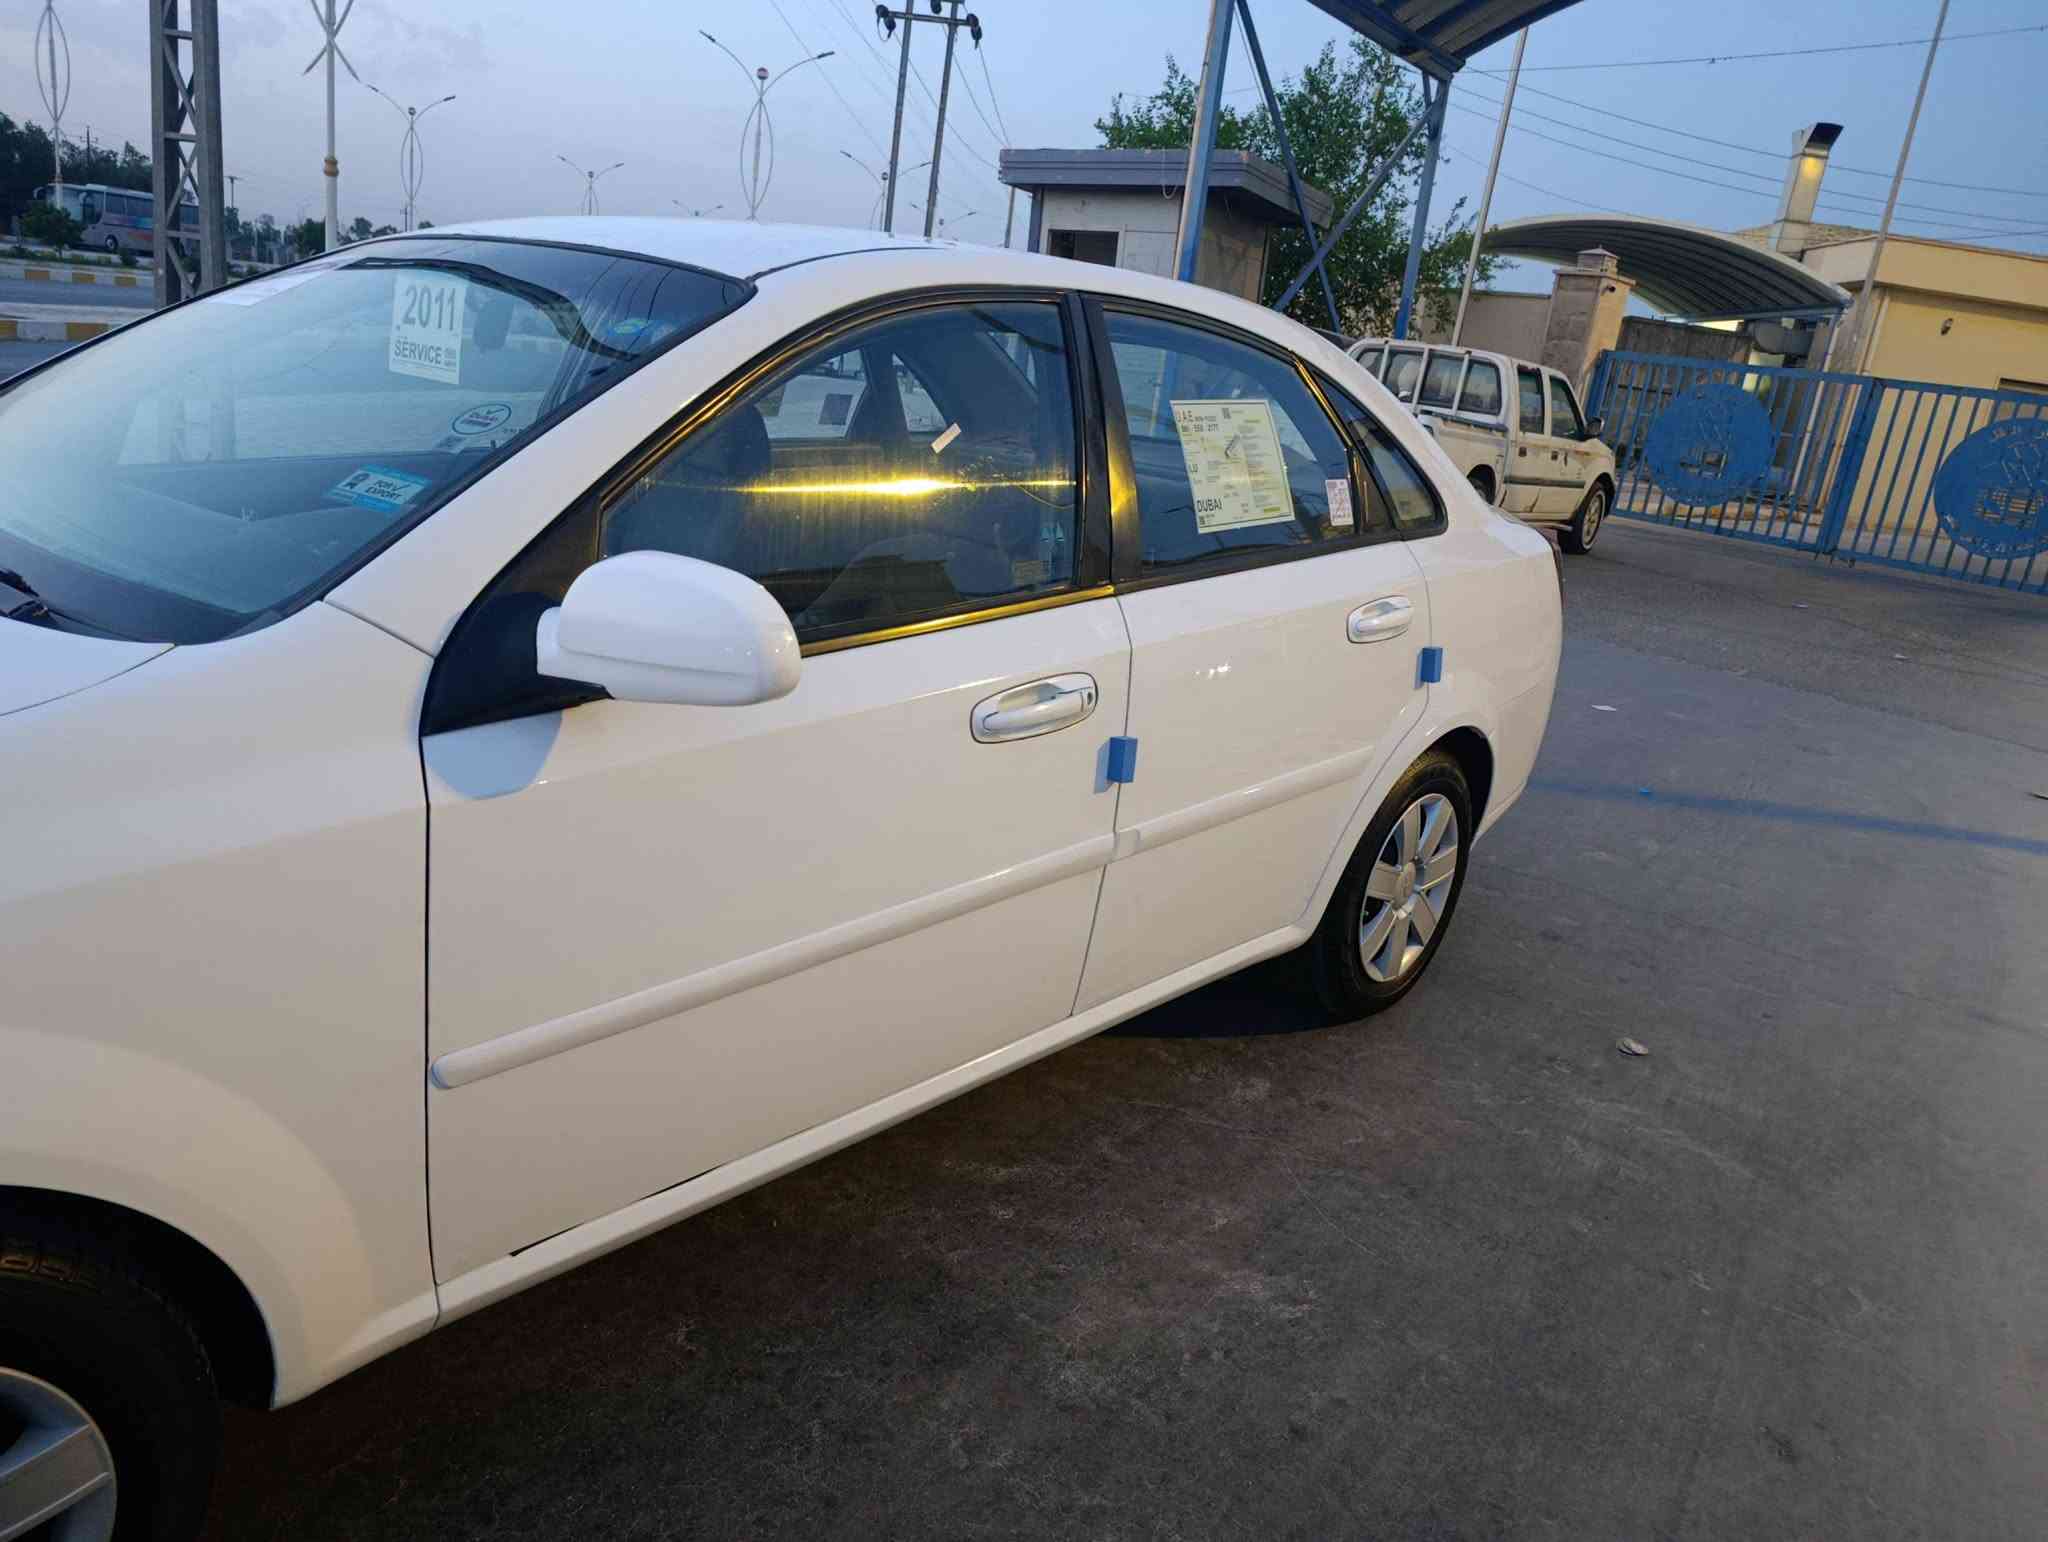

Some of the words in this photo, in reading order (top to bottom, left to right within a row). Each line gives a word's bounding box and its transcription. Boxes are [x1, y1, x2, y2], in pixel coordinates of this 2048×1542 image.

[402, 285, 456, 331] 2011
[393, 340, 443, 365] SERVICE
[1197, 496, 1223, 513] DUBAI
